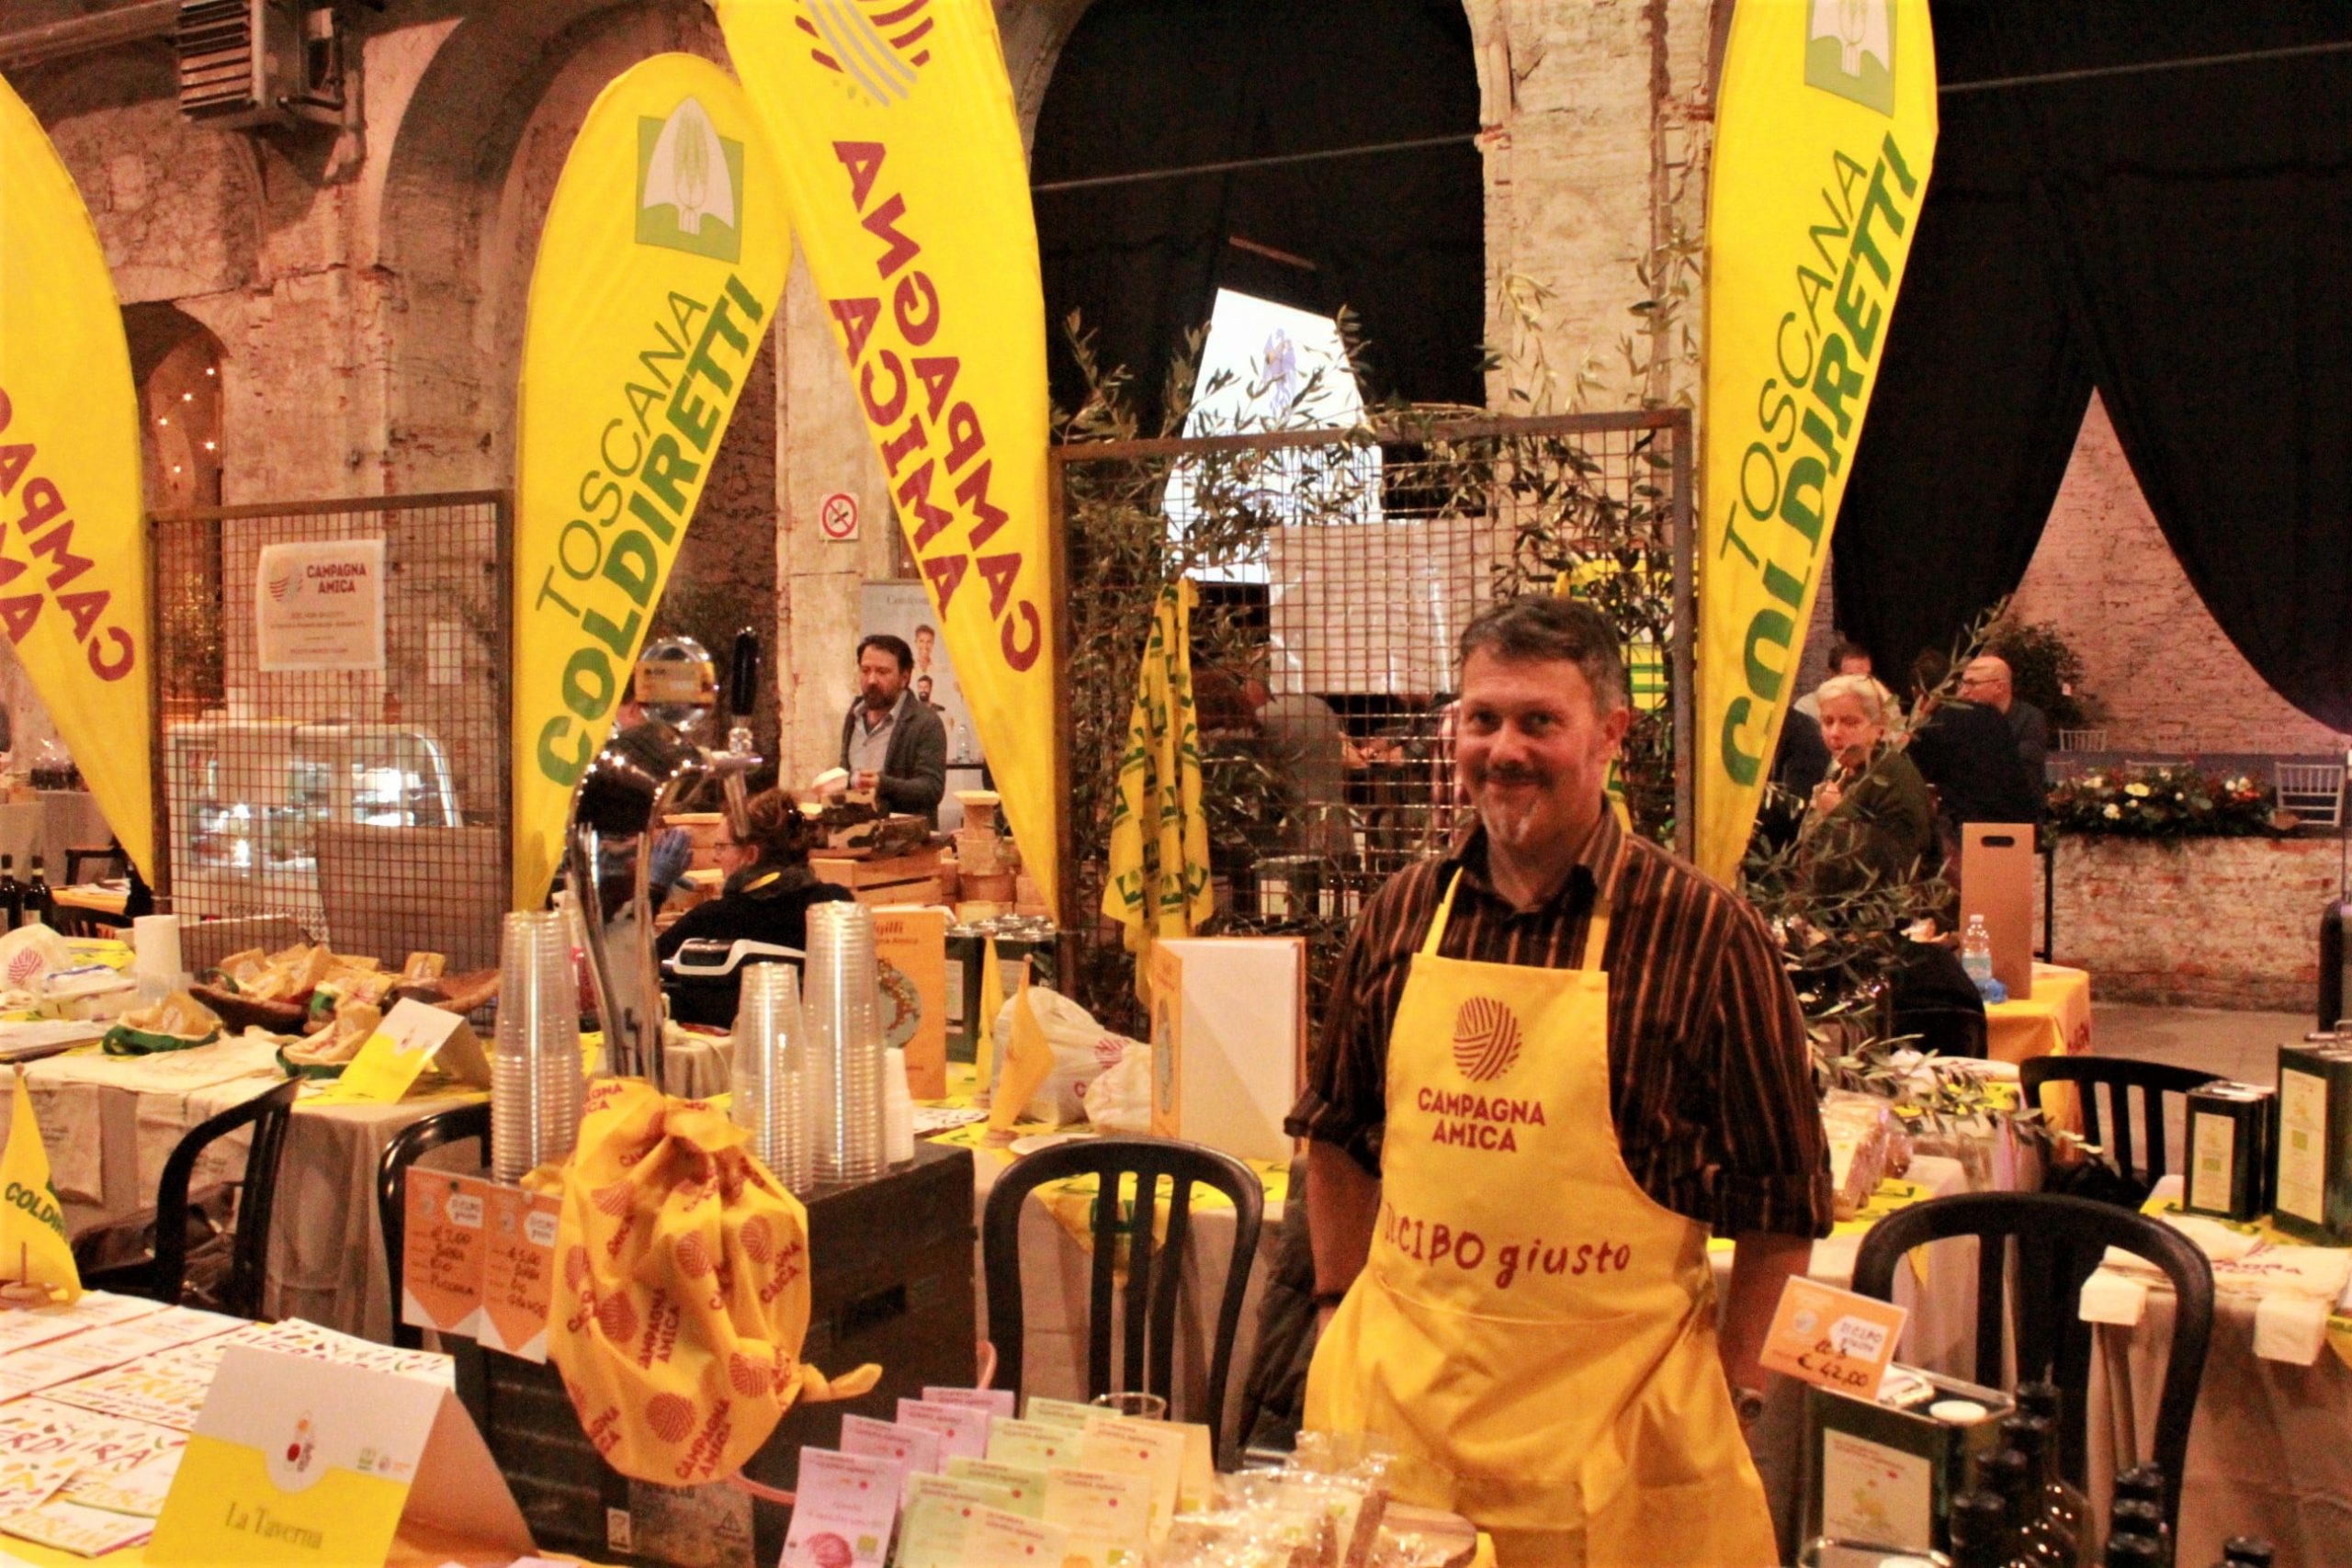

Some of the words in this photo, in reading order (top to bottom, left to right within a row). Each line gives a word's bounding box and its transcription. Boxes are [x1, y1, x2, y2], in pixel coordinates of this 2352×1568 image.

[1720, 150, 1867, 570] TOSCANA
[536, 290, 707, 618] TOSCANA
[1721, 131, 1918, 787] COLDIRETTI
[537, 273, 764, 788] COLDIRETTI
[306, 562, 367, 579] CAMPAGNA
[317, 579, 356, 593] AMICA
[1417, 1087, 1546, 1127] CAMPAGNA
[1431, 1120, 1518, 1154] AMICA
[1397, 1215, 1486, 1270] CIBO
[1495, 1237, 1632, 1291] giusto
[674, 1397, 732, 1480] CAMPAGNA
[699, 1422, 732, 1479] AMICA
